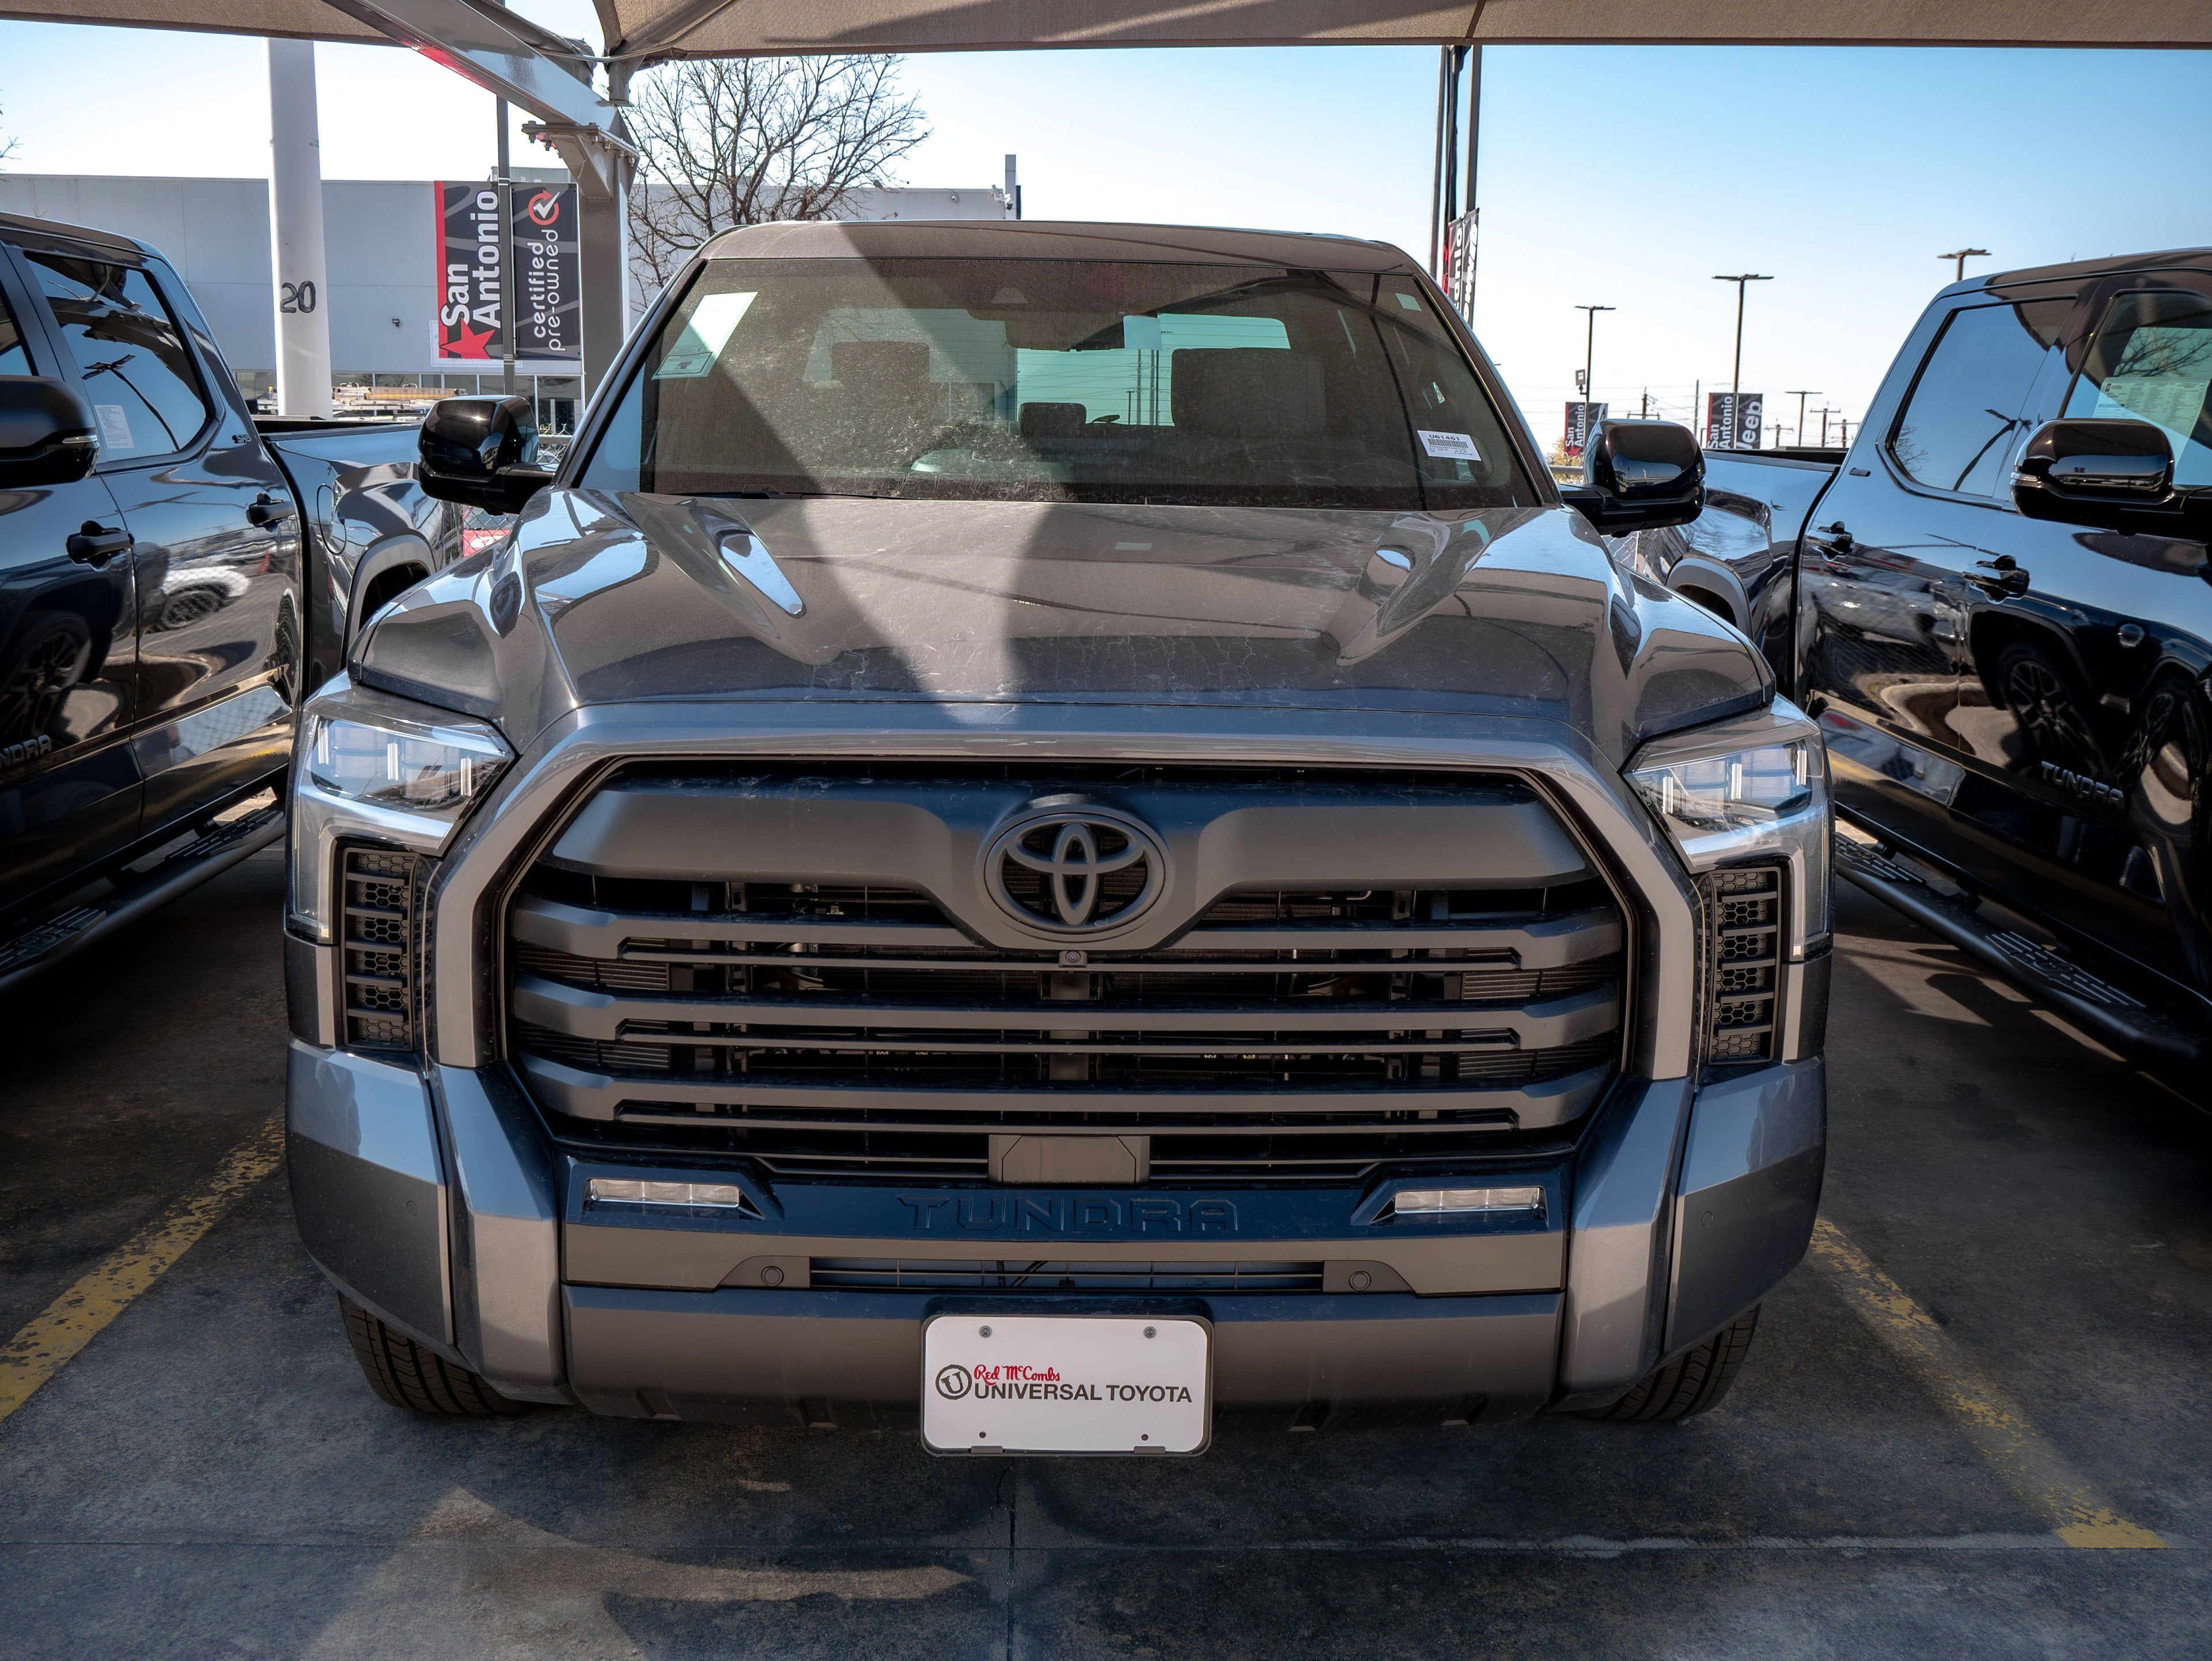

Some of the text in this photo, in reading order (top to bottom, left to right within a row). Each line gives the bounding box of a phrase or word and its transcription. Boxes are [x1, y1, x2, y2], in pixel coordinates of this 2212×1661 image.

[470, 191, 501, 329] Antonio
[280, 281, 316, 313] 20
[441, 264, 469, 326] San
[527, 242, 546, 338] certified
[541, 229, 566, 351] pre-owned
[1565, 427, 1574, 447] San
[1574, 404, 1584, 447] Antonio
[1706, 424, 1719, 449] San
[1719, 396, 1732, 449] Antonio
[2041, 760, 2125, 809] TUNDRA
[896, 1195, 1238, 1232] TUNDRA
[974, 1364, 1060, 1386] Red McCombs
[974, 1383, 1192, 1403] UNIVERSAL TOYOTA
